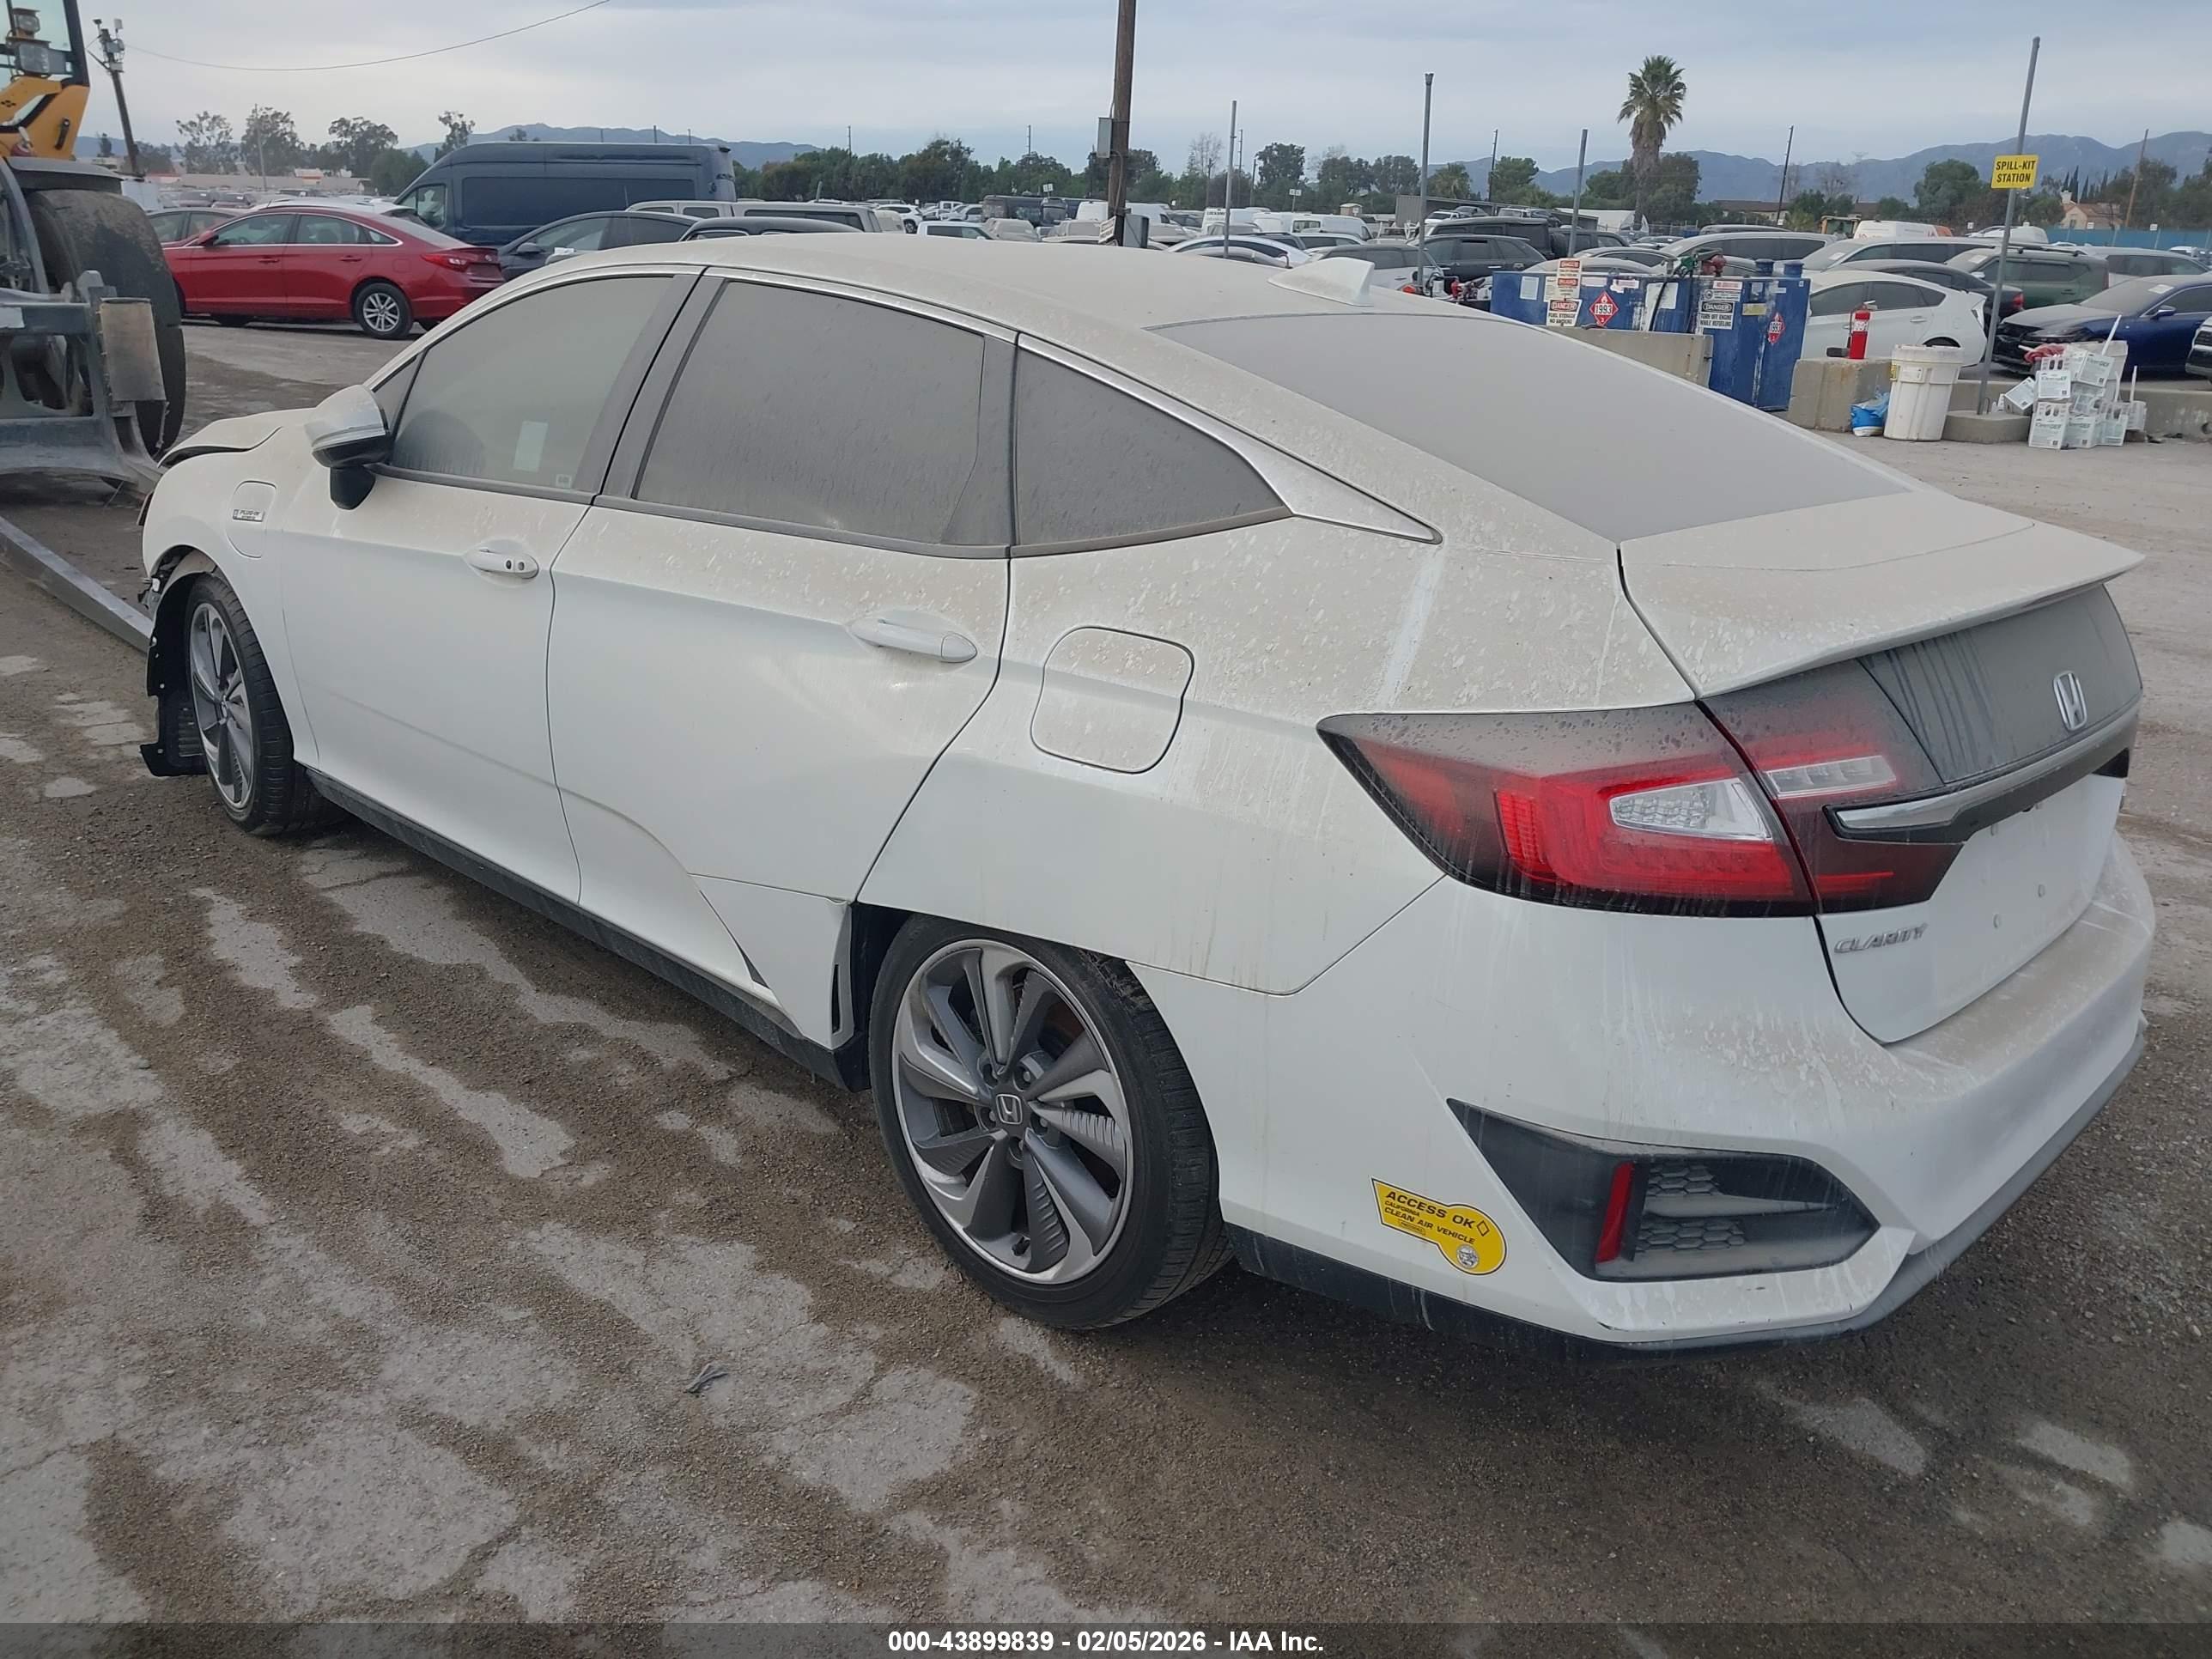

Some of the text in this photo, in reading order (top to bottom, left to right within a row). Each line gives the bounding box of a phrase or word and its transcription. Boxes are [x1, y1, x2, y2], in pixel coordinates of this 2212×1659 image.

[1996, 161, 2036, 170] SPILL-KIT
[1996, 173, 2031, 182] STATION
[1553, 301, 1576, 310] DANGER
[1595, 305, 1612, 314] 1993
[1834, 923, 1929, 953] CLARITY
[1384, 1200, 1420, 1217] CALIFORNIA
[1386, 1191, 1476, 1229] ACCESS OK
[1384, 1206, 1415, 1223] CLEAN
[1417, 1219, 1434, 1230] AIR
[1437, 1225, 1476, 1244] VEHICLE
